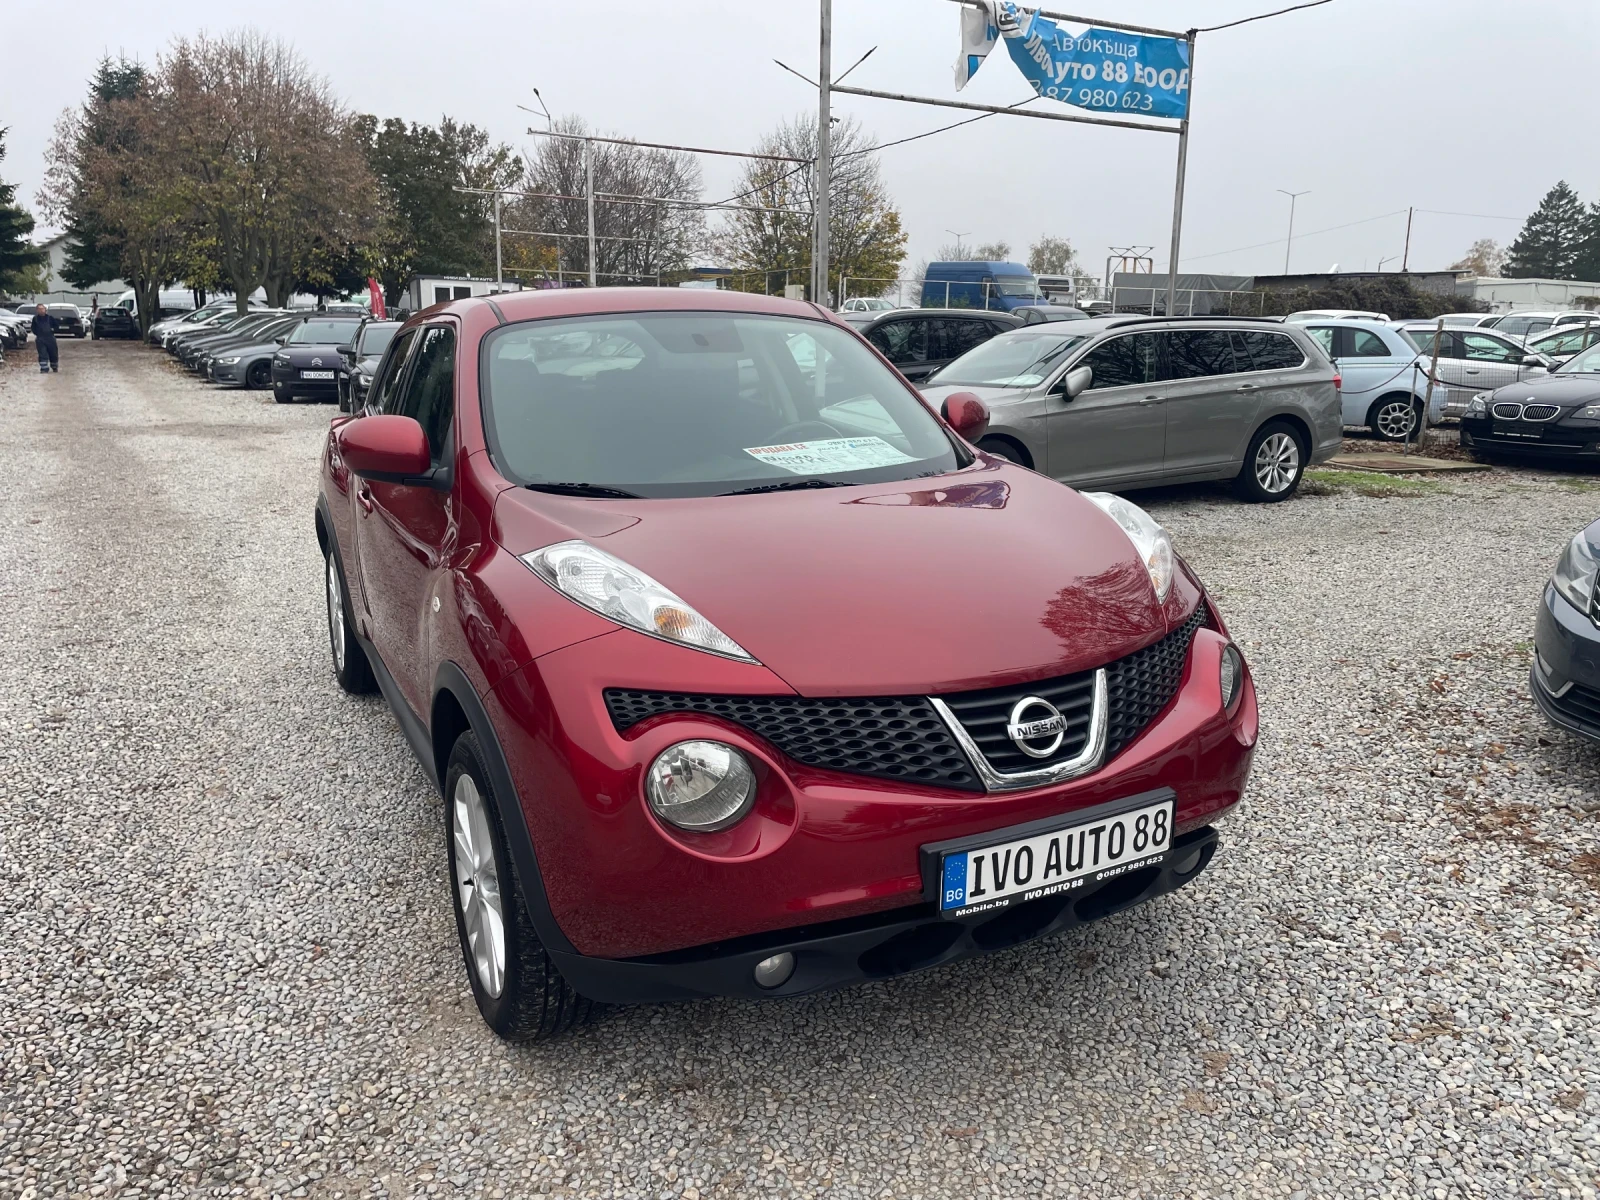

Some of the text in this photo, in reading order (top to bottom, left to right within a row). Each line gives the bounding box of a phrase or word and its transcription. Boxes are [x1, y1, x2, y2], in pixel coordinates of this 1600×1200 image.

[1101, 60, 1128, 83] 88
[1079, 88, 1118, 107] 980
[1122, 91, 1153, 111] 623
[748, 445, 795, 455] ПРОДАВА
[1017, 720, 1064, 737] NISSAN
[946, 808, 1168, 902] BG IVO AUTO 88
[955, 855, 1164, 917] Mobile.bg IVO AUTO 88 0887 980 623
